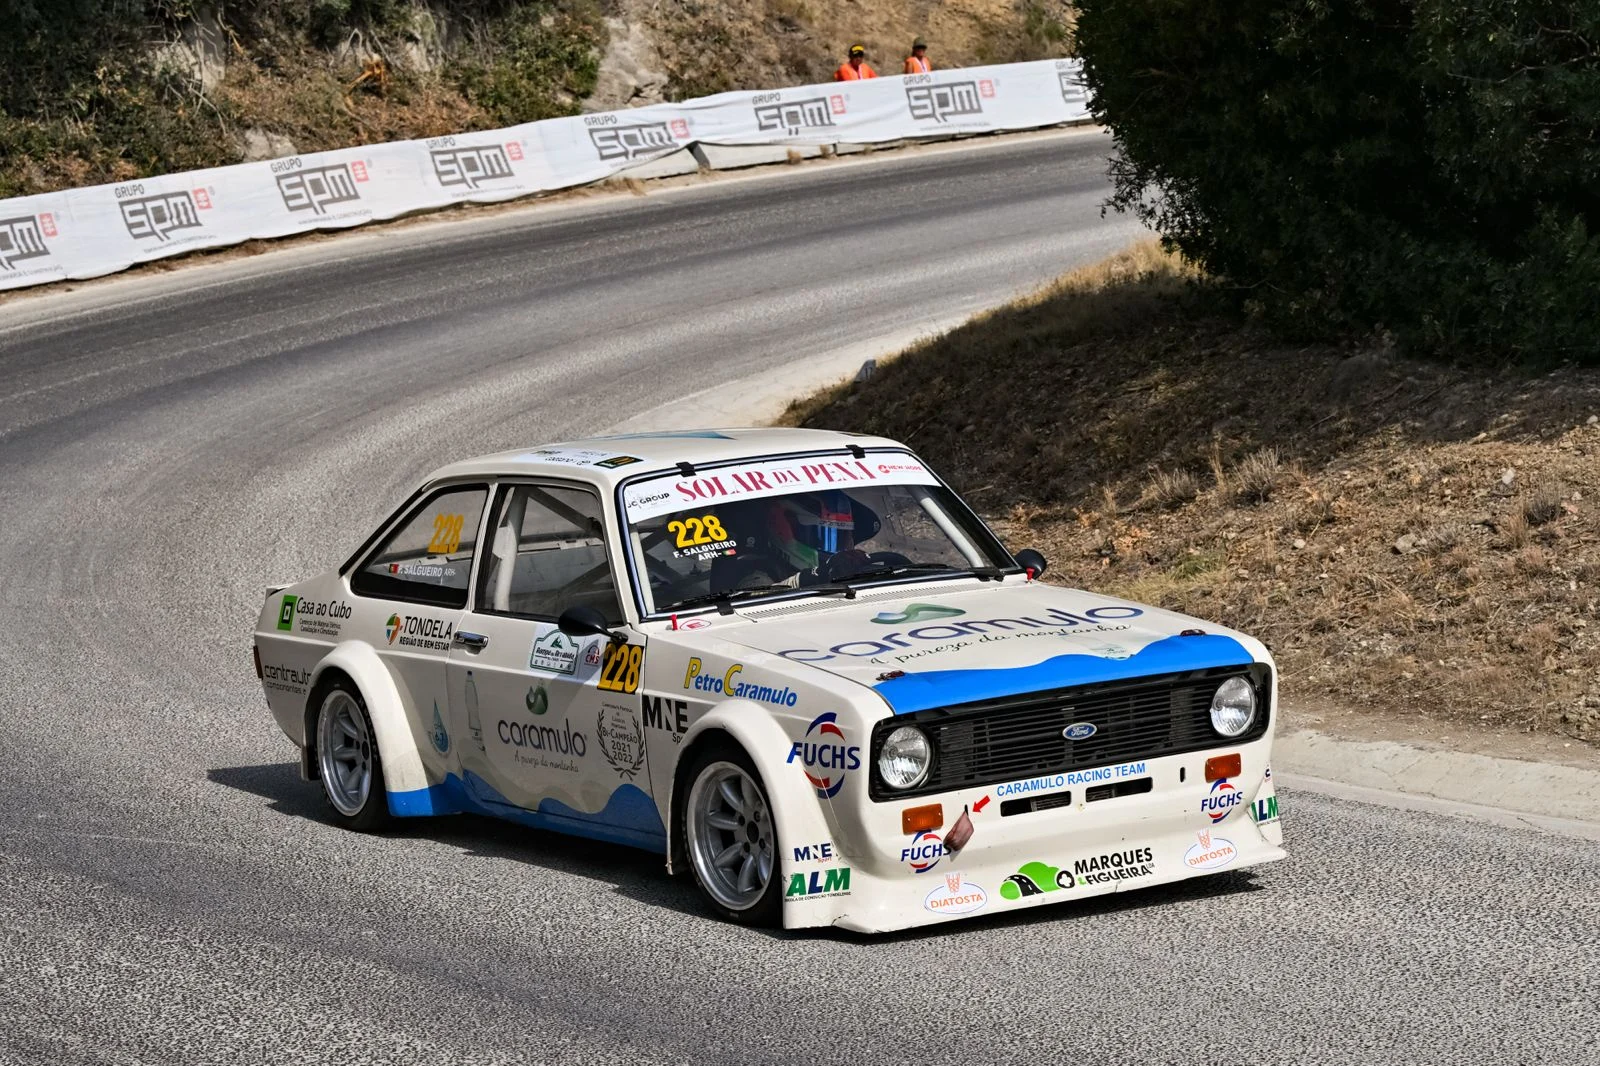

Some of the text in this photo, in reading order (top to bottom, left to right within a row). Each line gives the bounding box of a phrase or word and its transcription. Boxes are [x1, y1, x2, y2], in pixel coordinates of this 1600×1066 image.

[903, 74, 931, 85] GRUPO
[752, 92, 781, 105] GRUPO
[583, 114, 618, 126] GRUPO
[426, 137, 456, 149] GRUPO
[270, 157, 302, 173] GRUPO
[115, 183, 145, 198] GRUPO
[675, 470, 774, 502] SOLAR
[772, 470, 801, 484] DA
[640, 492, 670, 504] GROUP
[427, 513, 464, 554] 228
[667, 515, 728, 548] 228
[673, 540, 737, 559] F. SALGUEIRO
[404, 564, 443, 577] SALGUEIRO
[296, 597, 352, 619] Casa ao Cubo
[403, 616, 453, 640] TONDELA
[777, 606, 1144, 661] caramulo
[399, 636, 450, 651] REGIÃO DE BEM ESTAR
[895, 640, 973, 663] pureza
[979, 634, 1011, 643] da
[1015, 623, 1132, 638] montanha
[585, 654, 600, 664] CMS
[598, 643, 642, 693] 228
[684, 656, 797, 707] PetroCaramulo
[498, 718, 586, 757] caramulo
[611, 740, 631, 753] 2021
[613, 751, 633, 764] 2022
[786, 742, 861, 770] FUCHS
[997, 762, 1146, 797] CARAMULO RACING TEAM
[1201, 791, 1243, 812] FUCHS
[1074, 847, 1153, 875] MARQUES
[1188, 847, 1233, 866] DIATOSTA
[785, 867, 851, 897] ALM
[930, 894, 983, 909] DIATOSTA
